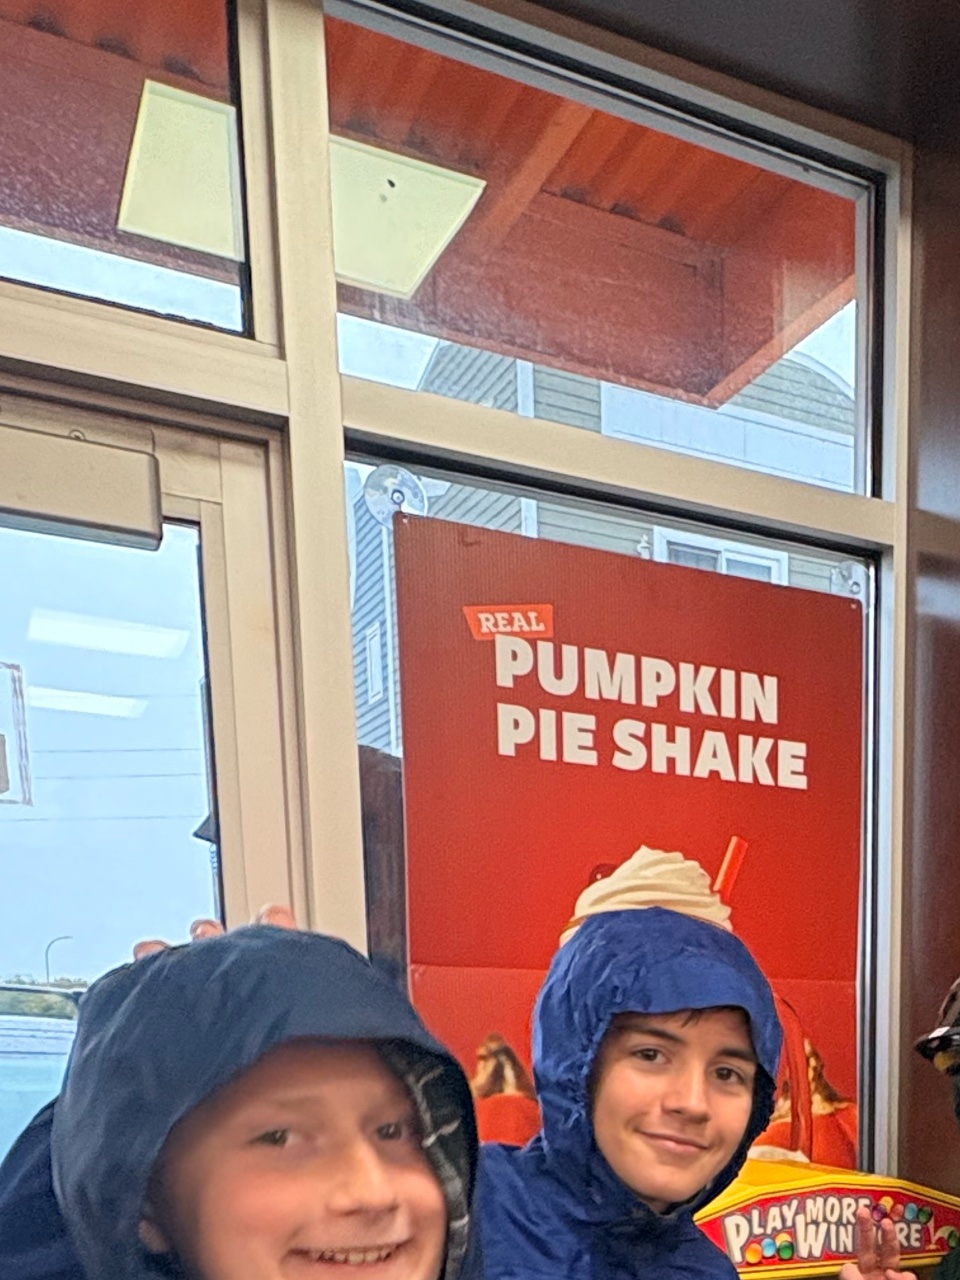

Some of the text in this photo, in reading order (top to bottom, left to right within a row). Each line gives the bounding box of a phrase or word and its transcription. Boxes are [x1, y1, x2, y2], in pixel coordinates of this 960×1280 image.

[478, 611, 546, 633] REAL
[495, 634, 778, 724] PUMPKIN
[497, 702, 808, 790] PIE SHAKE
[724, 1200, 798, 1263] PLAY
[796, 1214, 853, 1259] WIN
